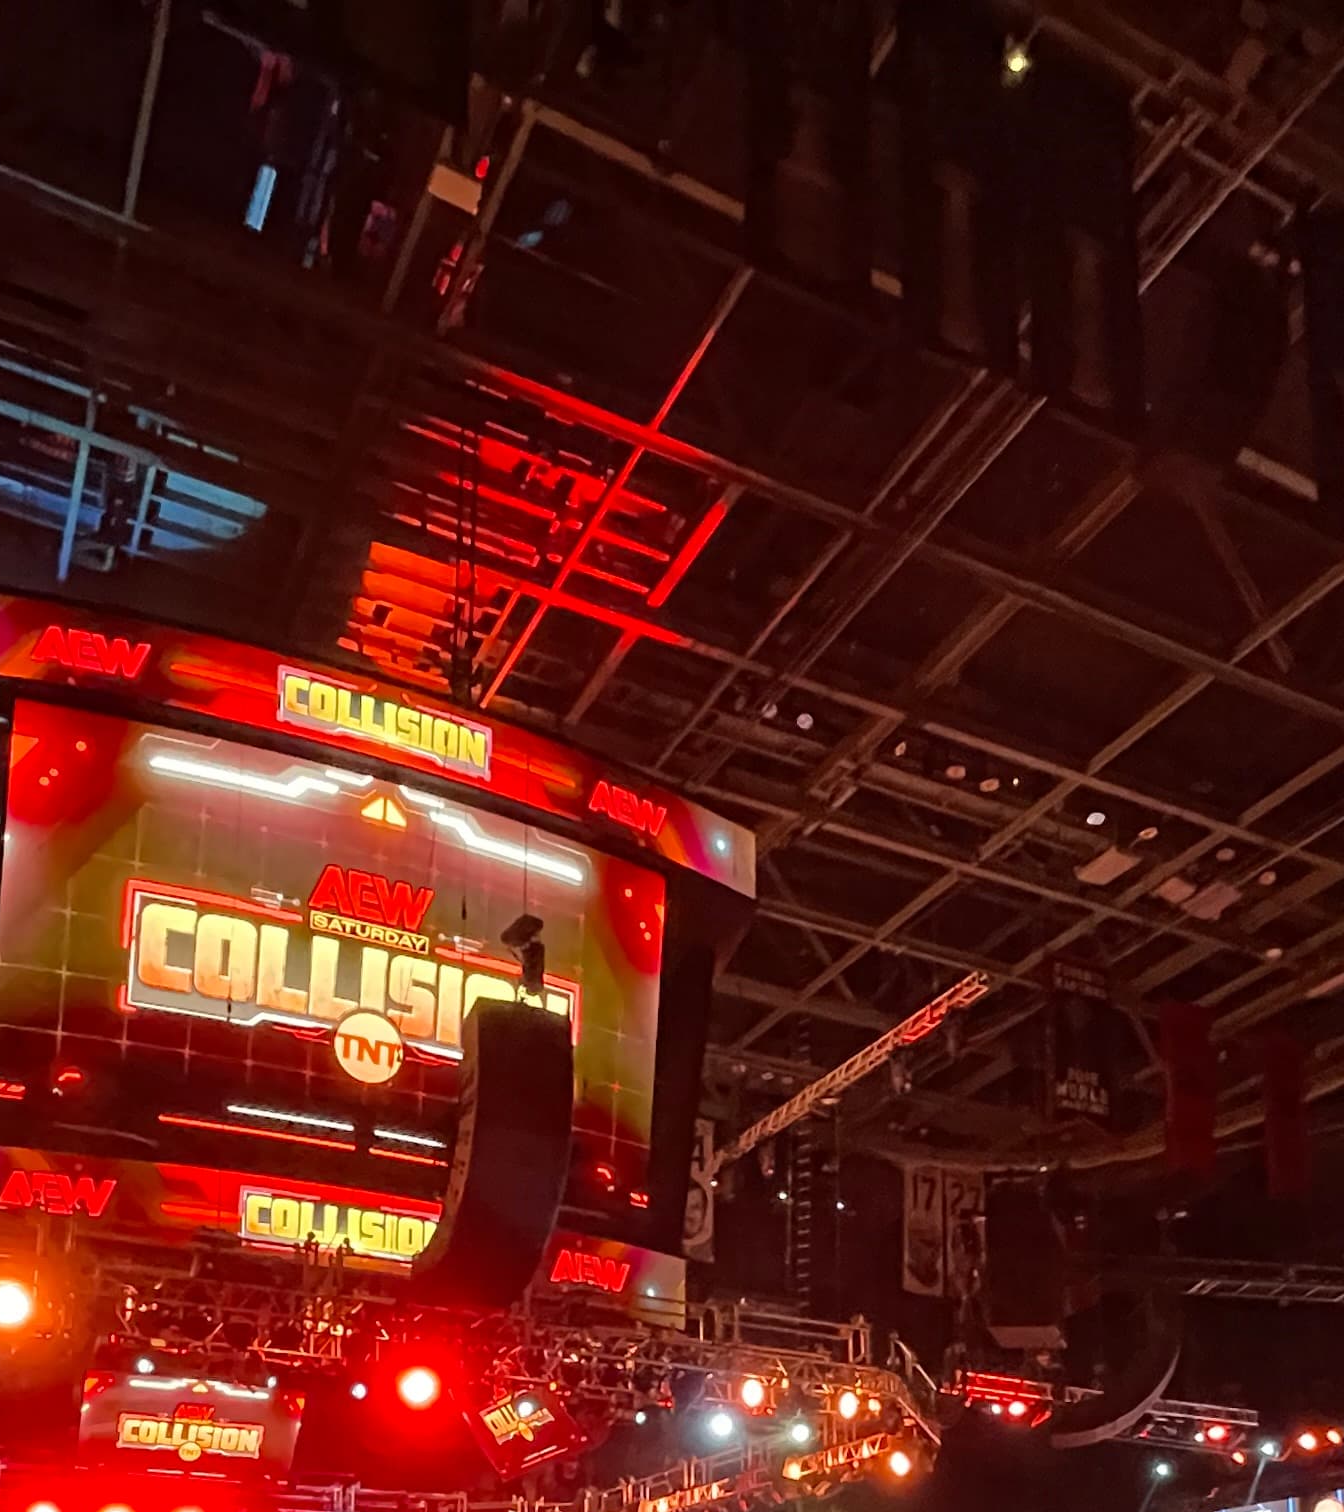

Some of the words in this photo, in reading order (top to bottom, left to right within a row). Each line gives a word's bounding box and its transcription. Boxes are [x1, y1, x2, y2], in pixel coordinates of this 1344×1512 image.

[31, 625, 152, 678] AEW
[284, 675, 487, 769] COLLISION
[588, 780, 668, 837] AEW
[308, 864, 434, 931] AEW
[313, 914, 427, 952] SATURDAY
[137, 902, 568, 1045] COLLISI
[337, 1032, 399, 1070] TNT
[913, 1174, 936, 1211] 17
[550, 1249, 630, 1294] AEW
[123, 1418, 259, 1452] COLLISION
